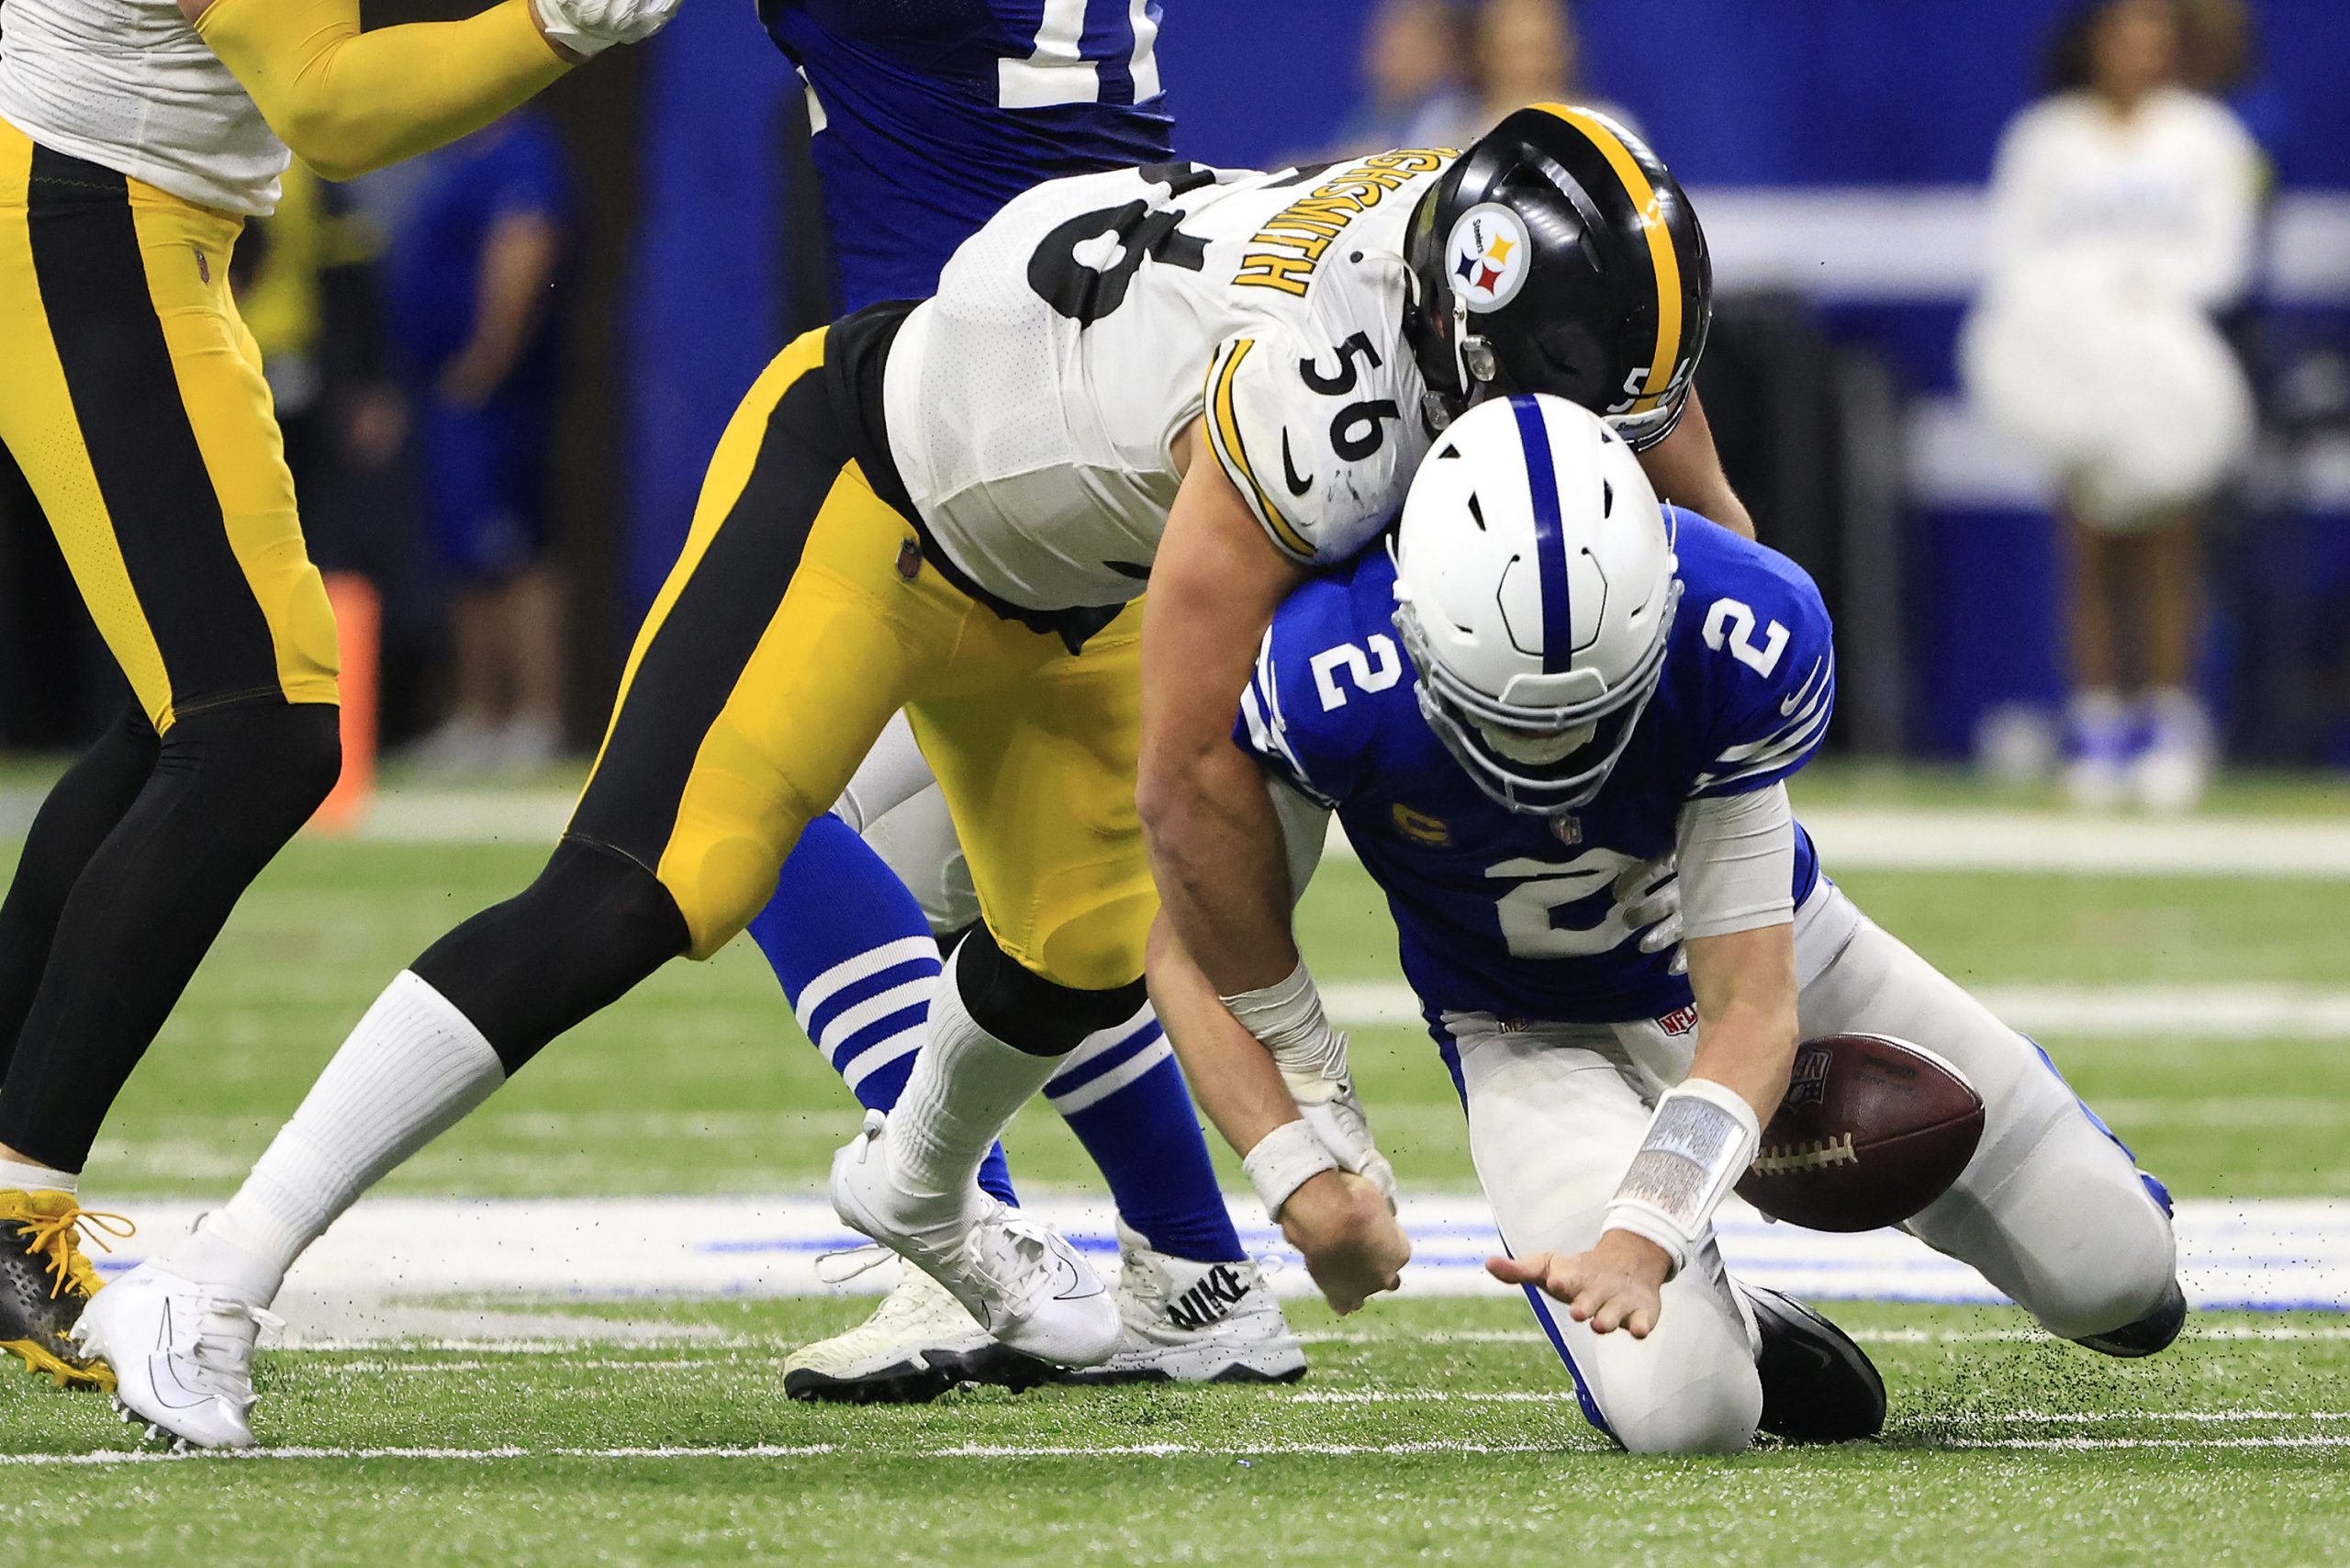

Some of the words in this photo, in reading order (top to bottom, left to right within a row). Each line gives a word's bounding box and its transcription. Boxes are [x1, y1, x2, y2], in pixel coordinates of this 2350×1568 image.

[1472, 219, 1483, 254] Steelers
[1299, 330, 1401, 462] 56
[1309, 633, 1403, 712] 2
[1702, 598, 1790, 679] 2
[1484, 847, 1643, 959] 2
[1661, 1007, 1695, 1034] NFL
[1166, 1265, 1250, 1331] NIKE
